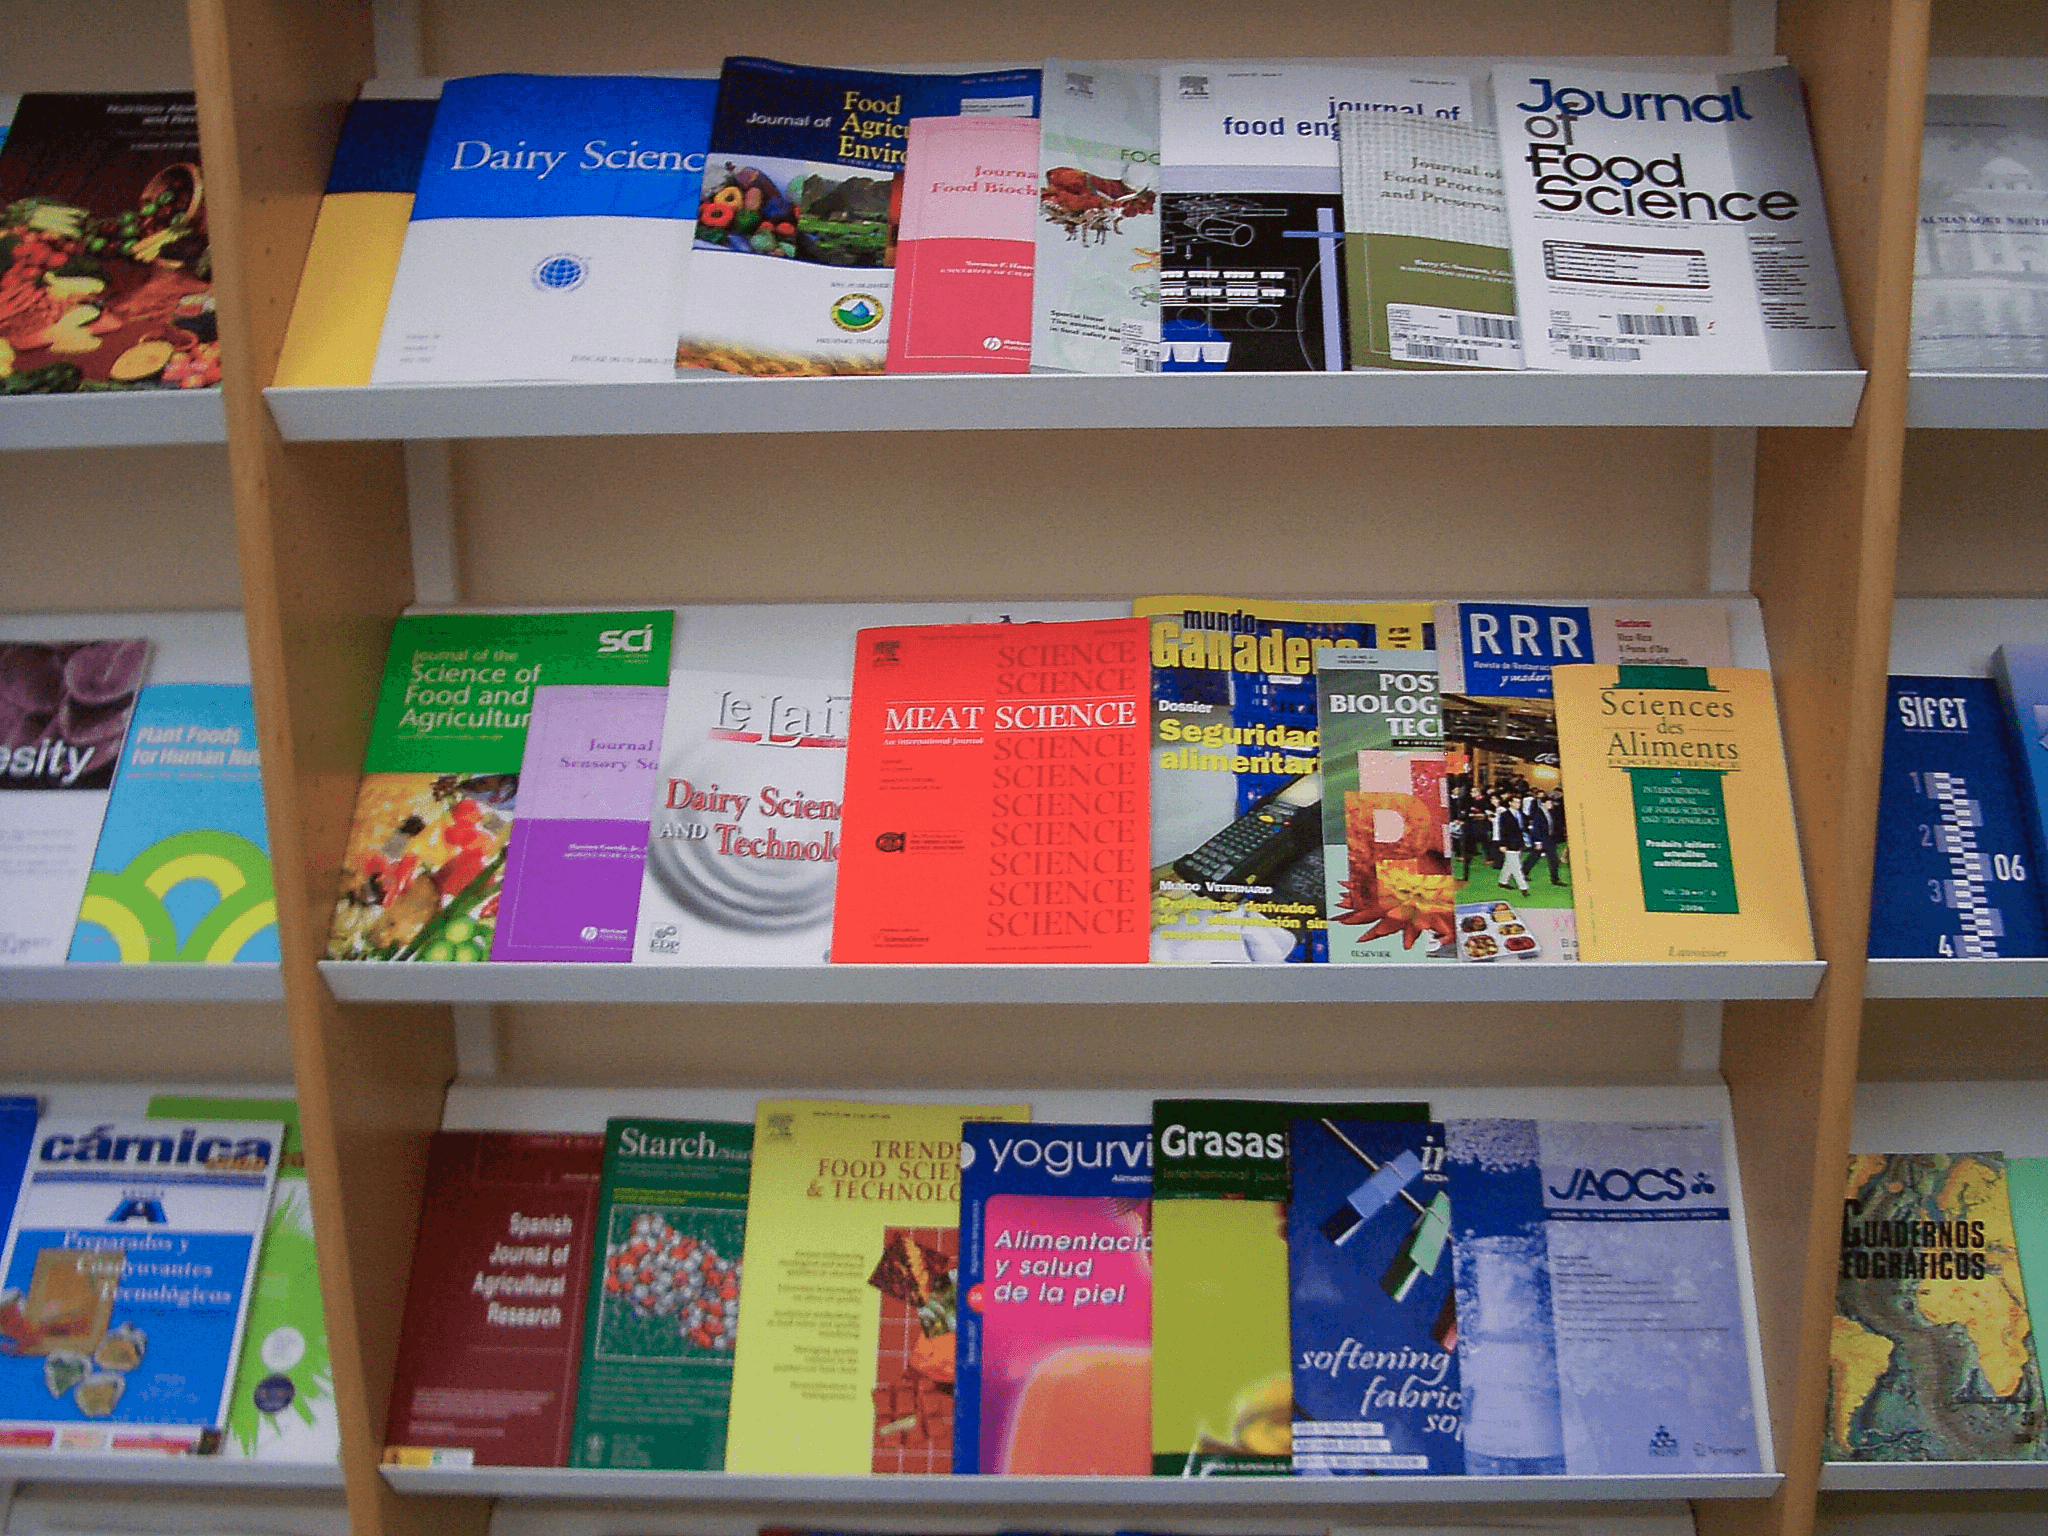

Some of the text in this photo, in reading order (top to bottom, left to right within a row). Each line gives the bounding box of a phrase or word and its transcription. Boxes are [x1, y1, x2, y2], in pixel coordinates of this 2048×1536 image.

[843, 92, 901, 115] Food
[1517, 78, 1753, 123] Journal
[746, 112, 832, 128] Journal of
[1223, 117, 1285, 136] food
[1524, 103, 1580, 146] of
[451, 139, 706, 180] Dairy Scienc
[1411, 157, 1479, 176] Journal
[1525, 143, 1686, 187] Food
[931, 181, 979, 193] Food
[1384, 171, 1429, 186] Food
[1380, 189, 1416, 201] and
[1535, 174, 1800, 222] Science
[1183, 609, 1256, 633] mundo
[597, 623, 653, 653] sci
[1151, 621, 1358, 675] Ganader
[411, 648, 468, 663] Journal
[997, 641, 1136, 668] SCIENCE
[410, 662, 543, 685] Science of
[995, 668, 1136, 696] SCIENCE
[403, 683, 530, 707] Food and
[1158, 699, 1214, 714] Dossier
[1329, 694, 1442, 714] BIOLOG
[1601, 690, 1735, 718] Sciences
[397, 706, 532, 734] Agricultur
[884, 701, 1136, 731] MEAT SCIENCE
[1656, 716, 1684, 735] des
[1898, 697, 1968, 729] SIFET
[136, 725, 241, 745] Plant Foods
[589, 738, 654, 751] Journal
[993, 734, 1135, 761] SCIENCE
[1606, 730, 1739, 759] Aliments
[131, 747, 226, 766] for Human
[992, 762, 1135, 789] SCIENCE
[1909, 771, 1921, 794] 1
[664, 777, 750, 822] Dairy
[992, 790, 1135, 817] SCIENCE
[659, 822, 708, 841] AND
[990, 819, 1135, 846] SCIENCE
[1918, 824, 1934, 848] 2
[989, 849, 1135, 876] SCIENCE
[1993, 853, 2027, 882] 06
[988, 878, 1135, 905] SCIENCE
[1926, 879, 1943, 903] 3
[1244, 901, 1317, 914] derivados
[987, 909, 1135, 936] SCIENCE
[1938, 934, 1954, 957] 4
[1160, 1124, 1284, 1159] Grasas
[818, 1159, 886, 1178] FOOD
[807, 1182, 823, 1197] &
[1549, 1168, 1686, 1202] JAOCS
[508, 1212, 573, 1239] Spanish
[1842, 1198, 1985, 1248] CUADERNOS
[489, 1242, 571, 1267] Journal of
[995, 1257, 1094, 1279] y salud
[472, 1271, 567, 1299] Agricultural
[993, 1281, 1126, 1309] de la piel
[486, 1301, 563, 1328] Research
[1298, 1337, 1451, 1386] softening
[1359, 1375, 1462, 1417] fabric
